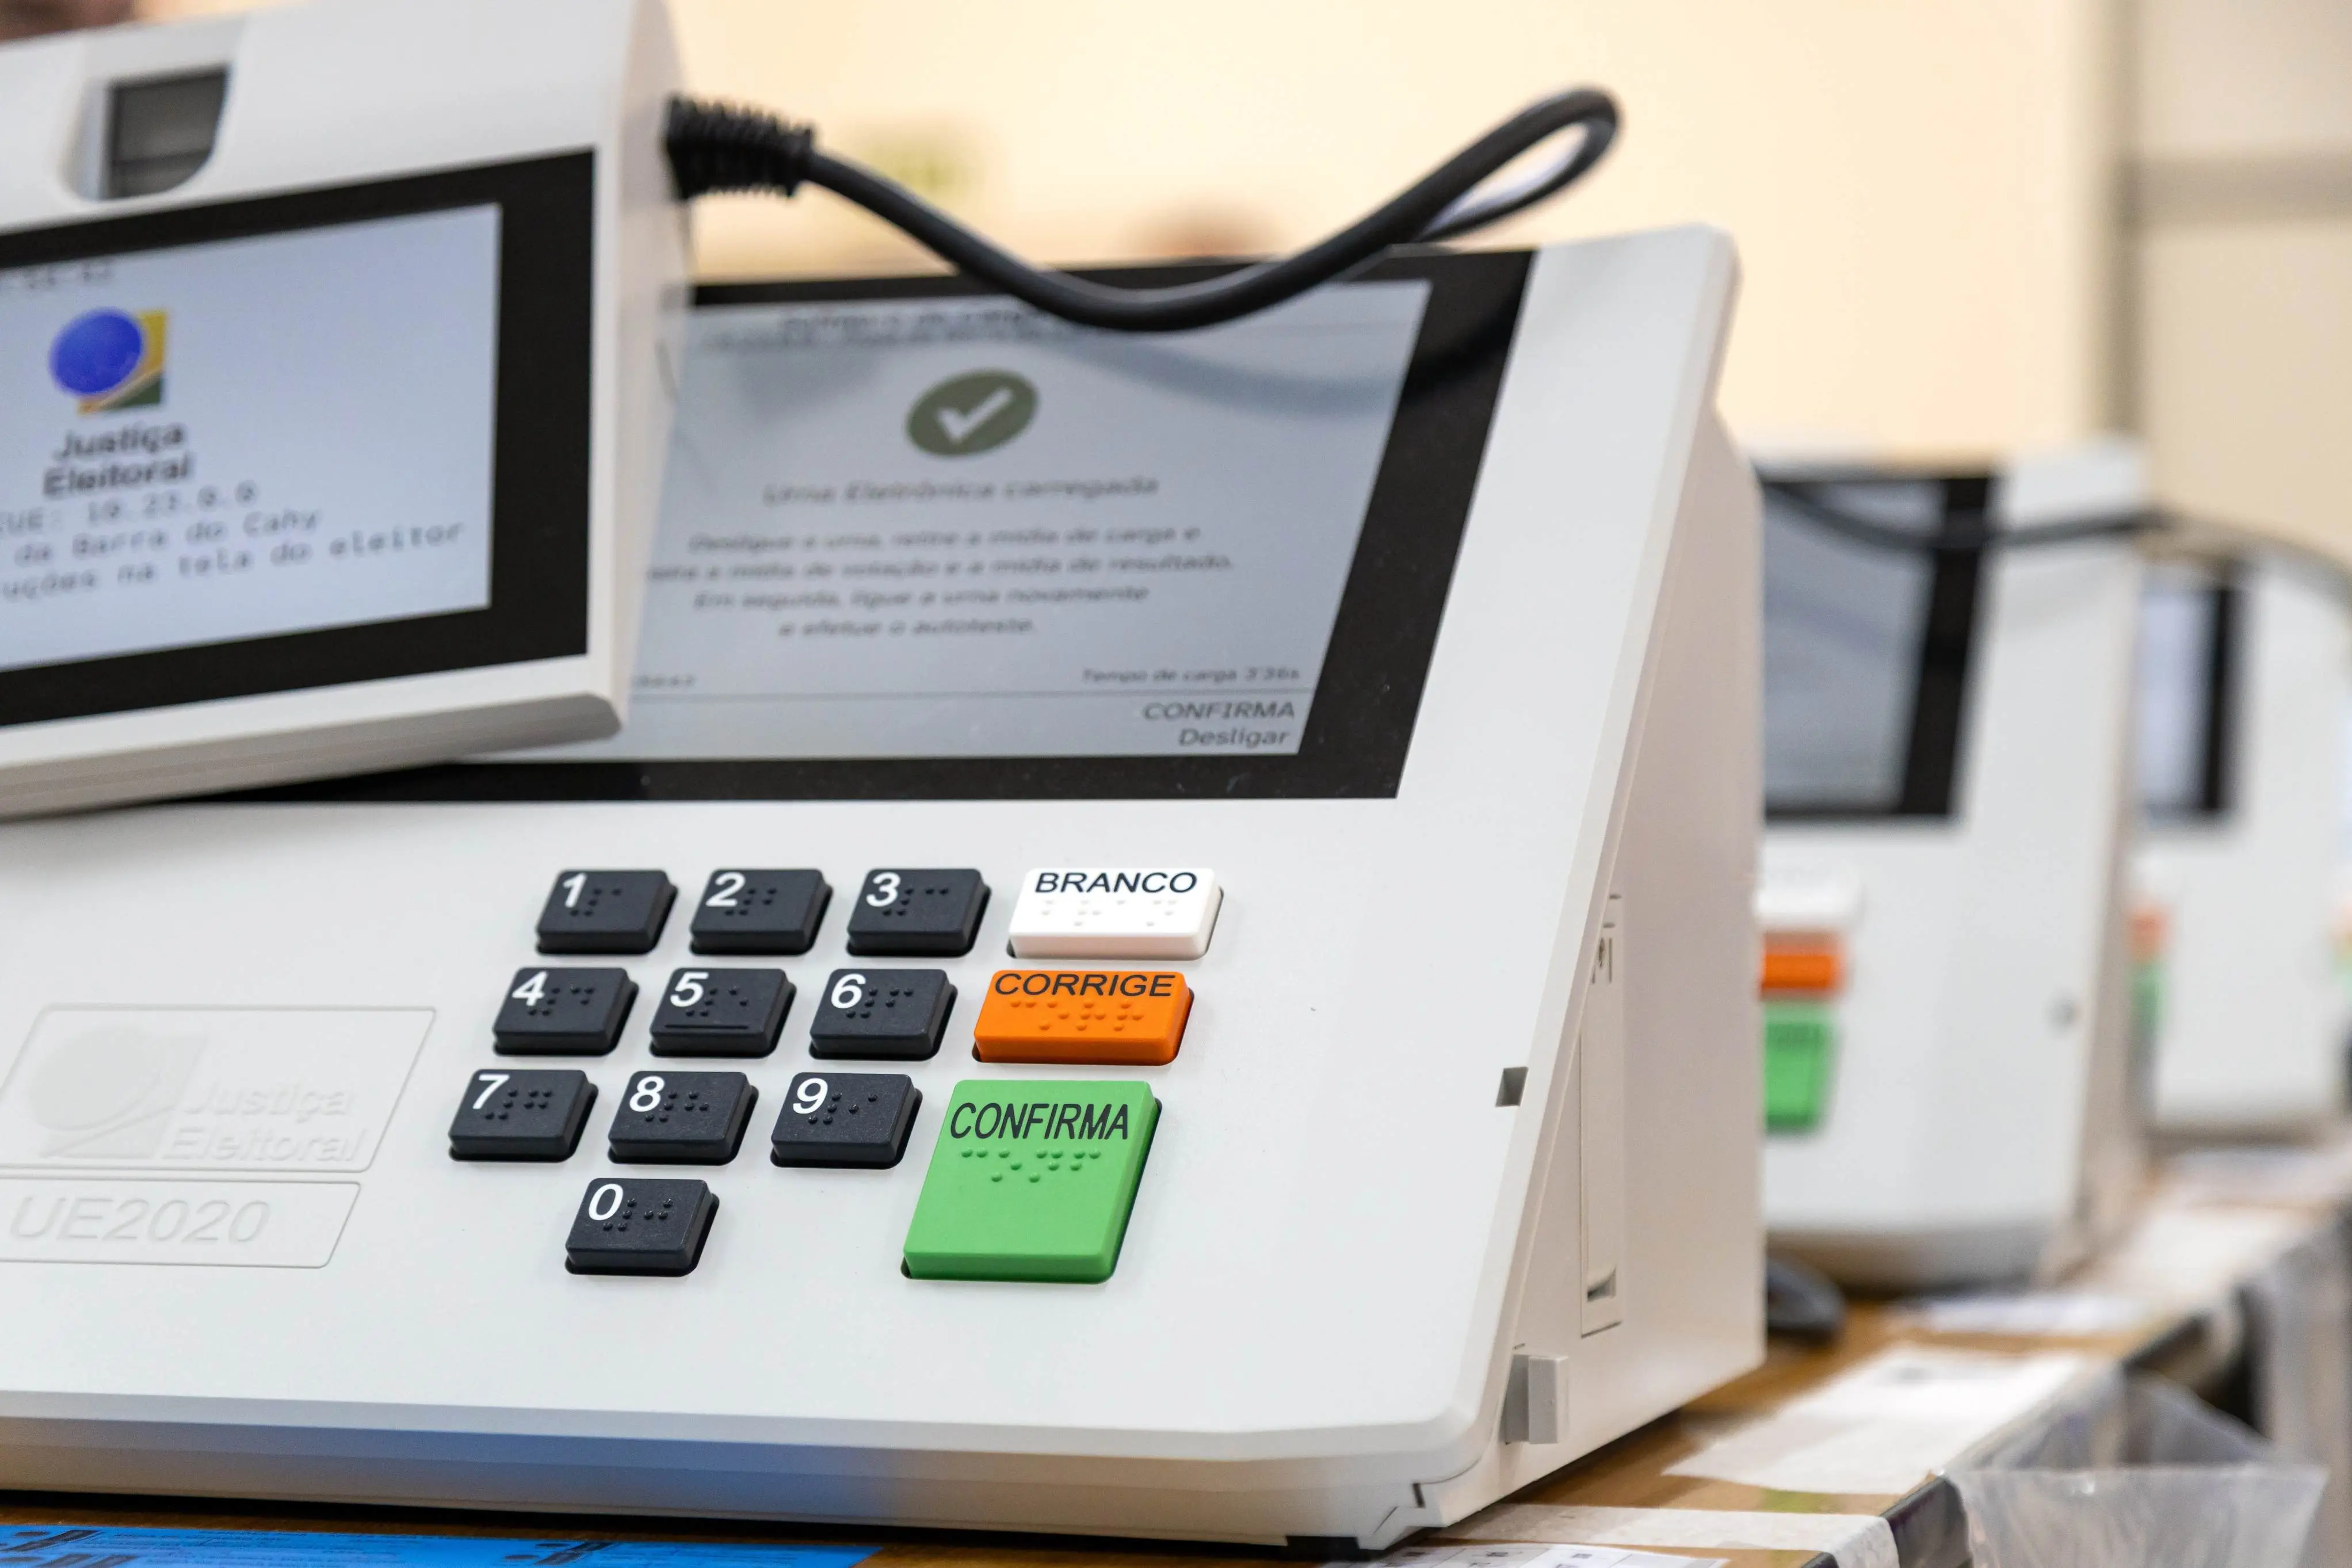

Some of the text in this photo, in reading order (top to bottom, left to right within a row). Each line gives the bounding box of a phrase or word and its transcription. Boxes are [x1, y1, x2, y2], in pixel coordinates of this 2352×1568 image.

[59, 423, 185, 459] Justiça
[43, 457, 196, 497] Eleitoral
[185, 521, 228, 545] do
[117, 563, 158, 584] na
[179, 546, 251, 575] tela
[272, 544, 311, 567] do
[330, 522, 462, 556] eleitor
[1083, 669, 1147, 683] Tempo
[1154, 669, 1177, 681] de
[1183, 669, 1237, 683] carga
[1143, 701, 1295, 720] CONFIRMA
[1178, 728, 1289, 748] Desligar
[563, 873, 587, 907] 1
[706, 872, 746, 907] 2
[866, 872, 901, 907] 3
[1035, 872, 1198, 893] BRANCO
[512, 972, 547, 1005] 4
[670, 972, 708, 1007] 5
[830, 973, 866, 1009] 6
[995, 973, 1175, 997] CORRIGE
[183, 1081, 357, 1124] Justiça
[472, 1074, 509, 1110] 7
[629, 1076, 666, 1113] 8
[793, 1079, 828, 1115] 9
[950, 1102, 1128, 1140] CONFIRMA
[161, 1126, 367, 1162] Eleitoral
[9, 1196, 270, 1244] UE2020
[589, 1184, 623, 1220] 0
